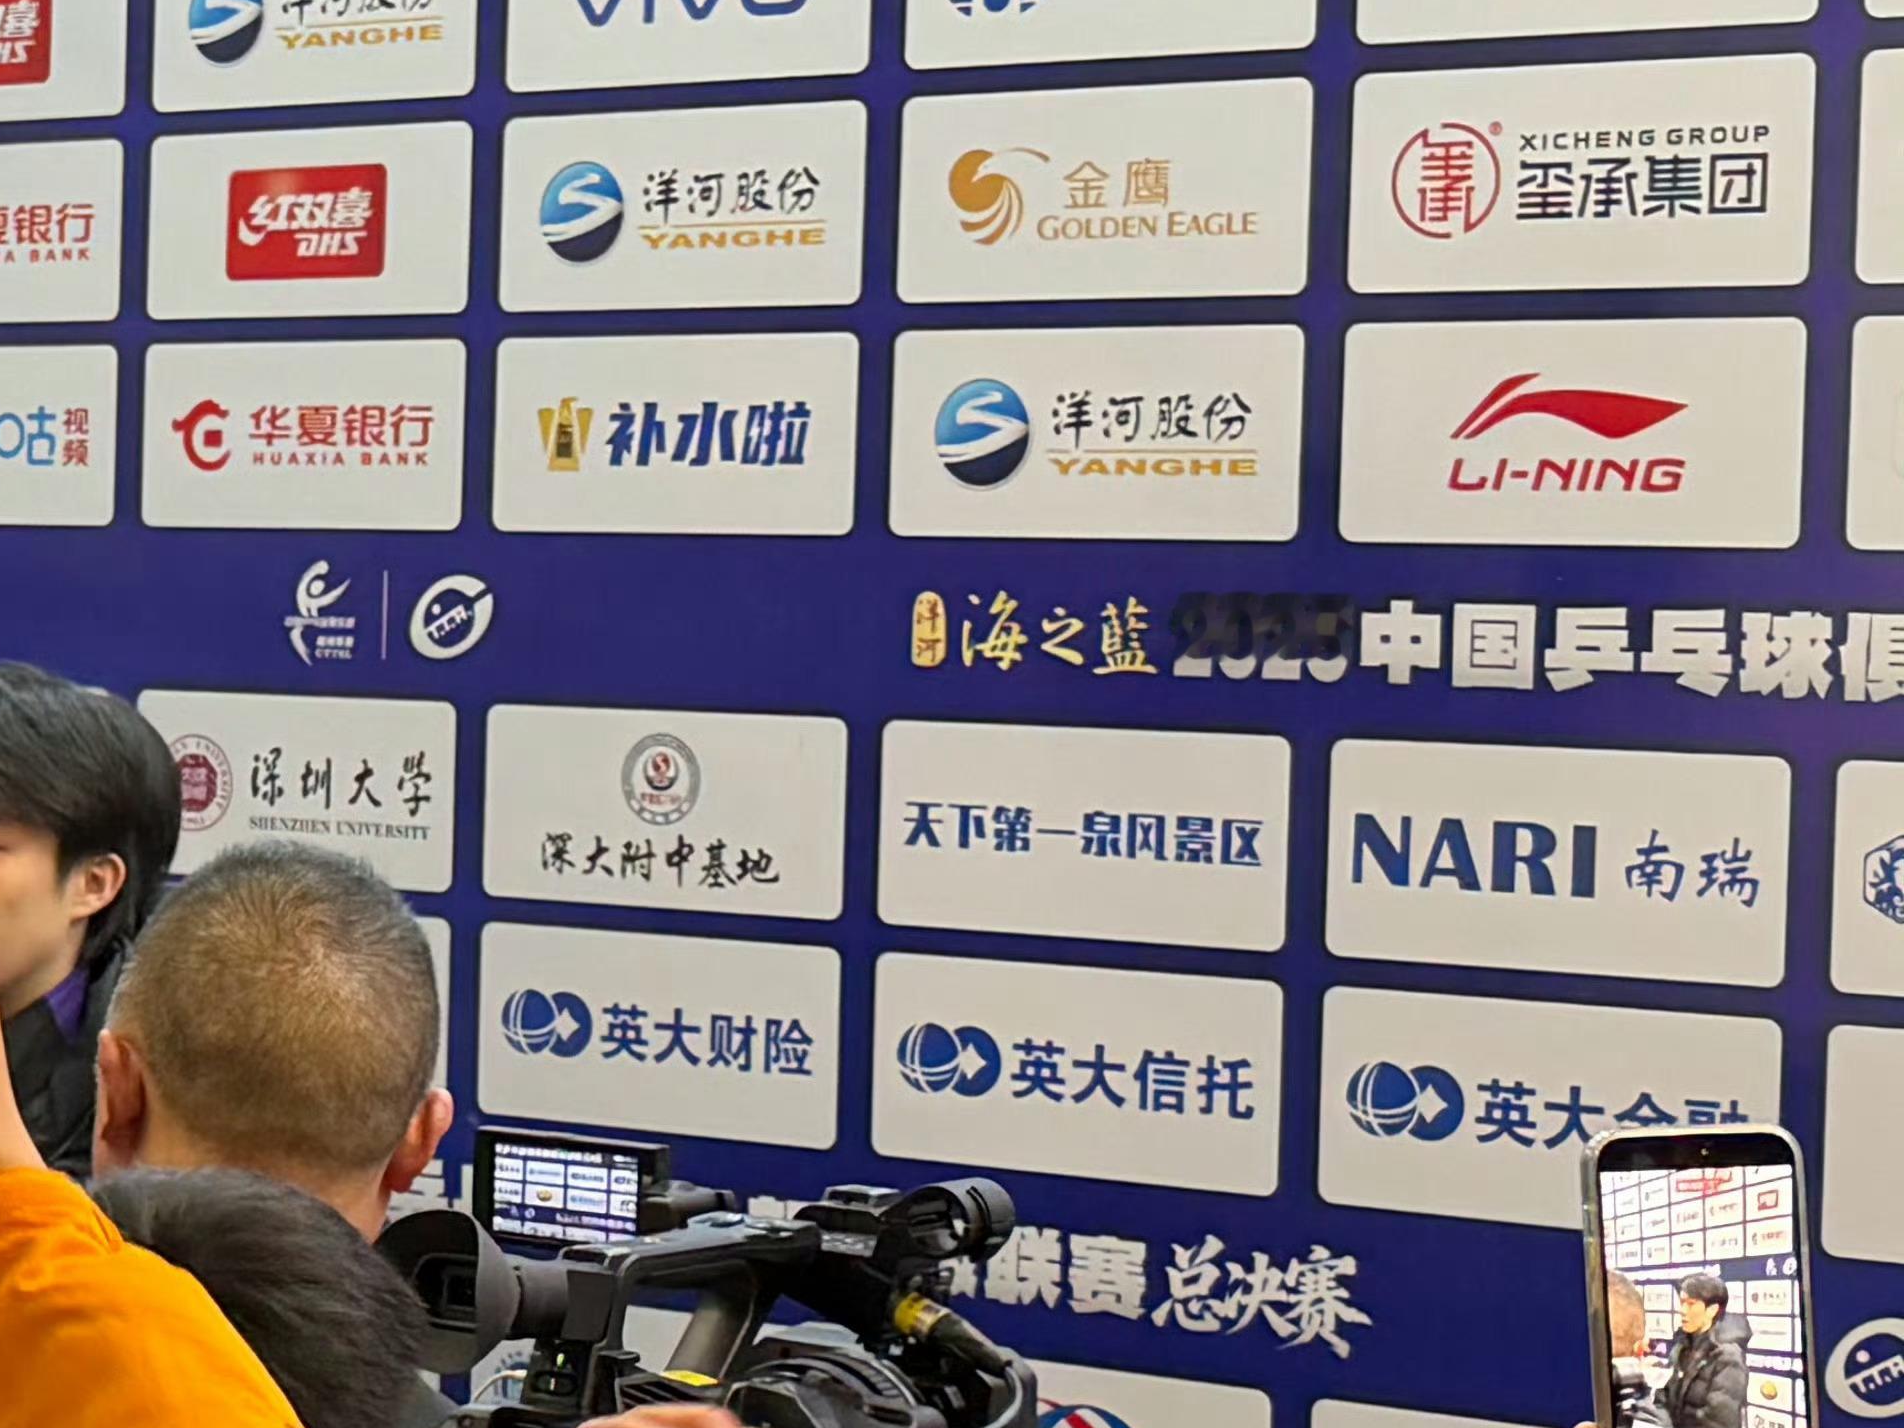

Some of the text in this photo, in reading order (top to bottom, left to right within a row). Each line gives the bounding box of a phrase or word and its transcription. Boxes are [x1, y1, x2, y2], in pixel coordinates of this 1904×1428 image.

[275, 22, 446, 51] YANGHE
[1518, 124, 1772, 152] XICHENG GROUP
[642, 167, 821, 226] 洋河股份
[1062, 157, 1173, 210] 金鹰
[1515, 152, 1770, 220] 玺承集团
[238, 185, 375, 247] 红双喜
[639, 227, 827, 250] YANGHE
[1037, 211, 1259, 242] GOLDEN EAGLE
[29, 247, 92, 264] BANK
[61, 405, 91, 469] 视频
[247, 403, 435, 449] 华夏银行
[604, 400, 813, 468] 补水啦
[1050, 390, 1254, 450] 洋河股份
[252, 451, 430, 468] HUAXIA BANK
[1047, 456, 1259, 477] YANGHE
[1446, 456, 1687, 494] LI-NING
[248, 814, 431, 842] SHENZHEN UNIVERSITY
[902, 799, 1264, 868] 天下第一泉风景区
[540, 829, 782, 890] 深大附中基地
[1349, 812, 1761, 909] NARI 南瑞
[600, 1001, 815, 1078] 英大财险
[1010, 1036, 1256, 1122] 英大信托
[938, 1224, 1375, 1360] 联赛 总决赛
